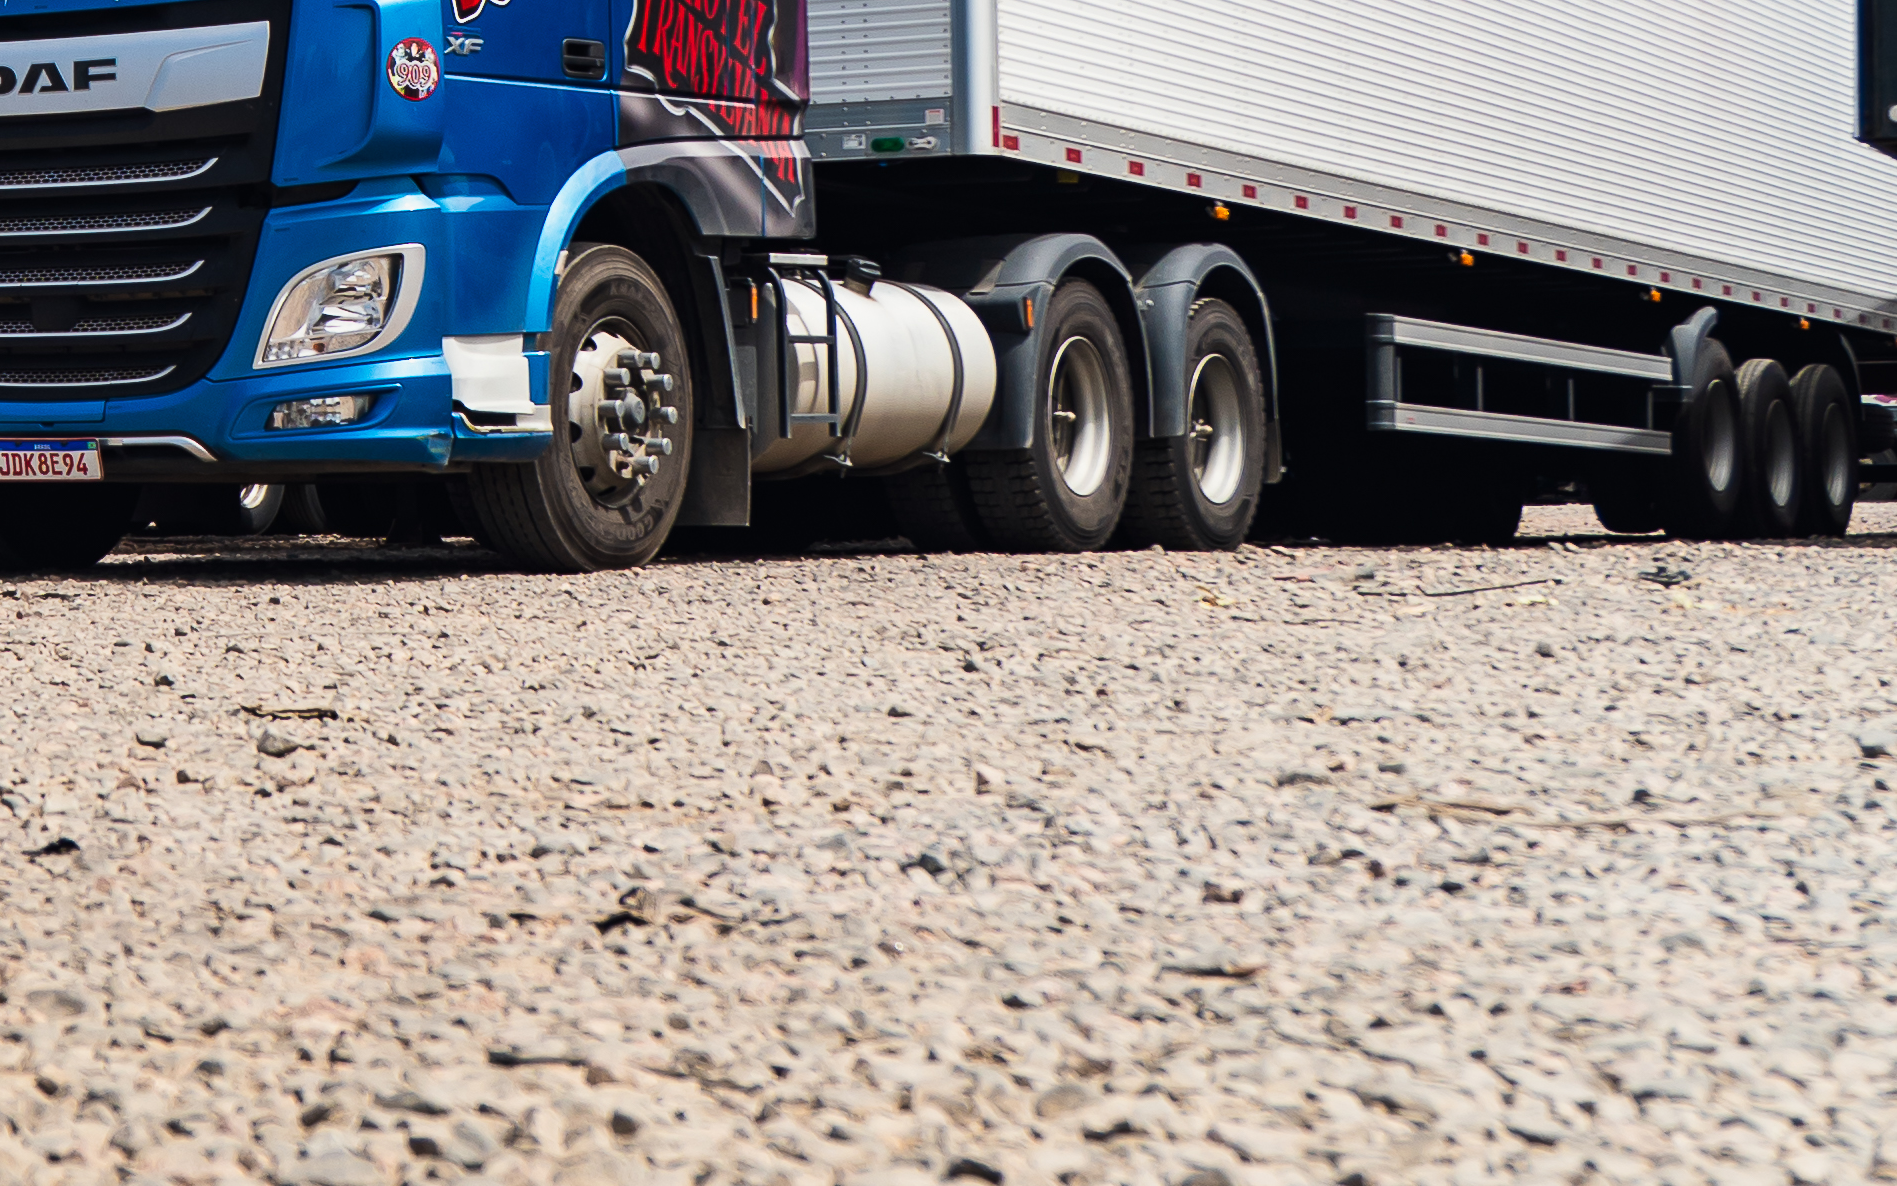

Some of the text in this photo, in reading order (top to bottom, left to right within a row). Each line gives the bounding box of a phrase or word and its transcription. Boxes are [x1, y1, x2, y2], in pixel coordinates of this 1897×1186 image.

[444, 36, 484, 55] XF
[396, 62, 432, 88] 909
[0, 452, 88, 476] JDK8E94
